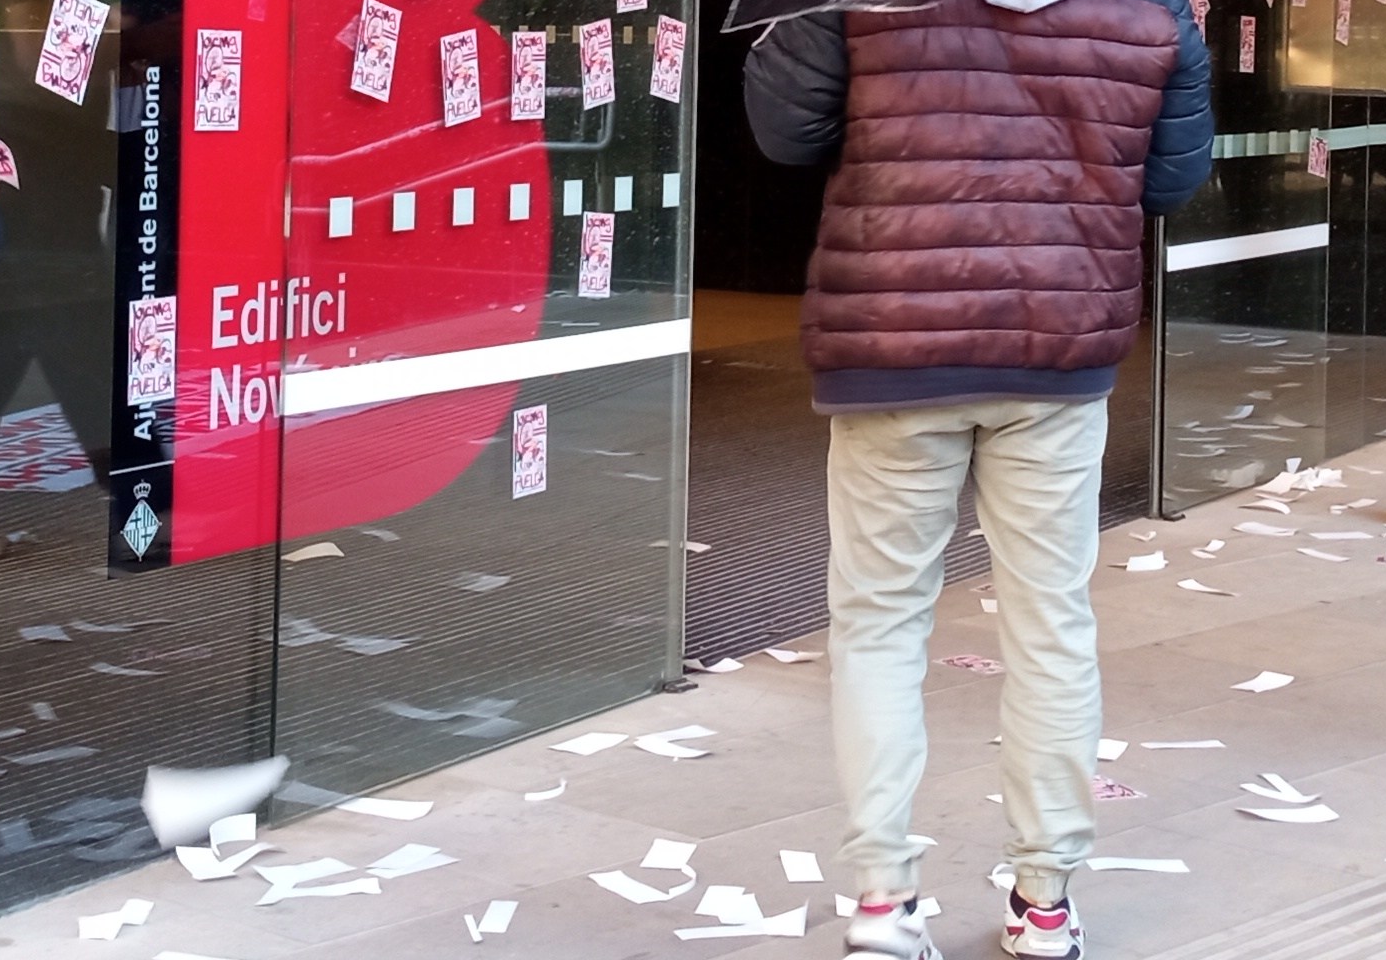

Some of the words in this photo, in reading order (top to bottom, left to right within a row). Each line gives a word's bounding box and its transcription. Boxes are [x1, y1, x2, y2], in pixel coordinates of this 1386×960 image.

[138, 66, 161, 211] Barcelona
[138, 220, 158, 255] de
[211, 272, 346, 349] Edifici
